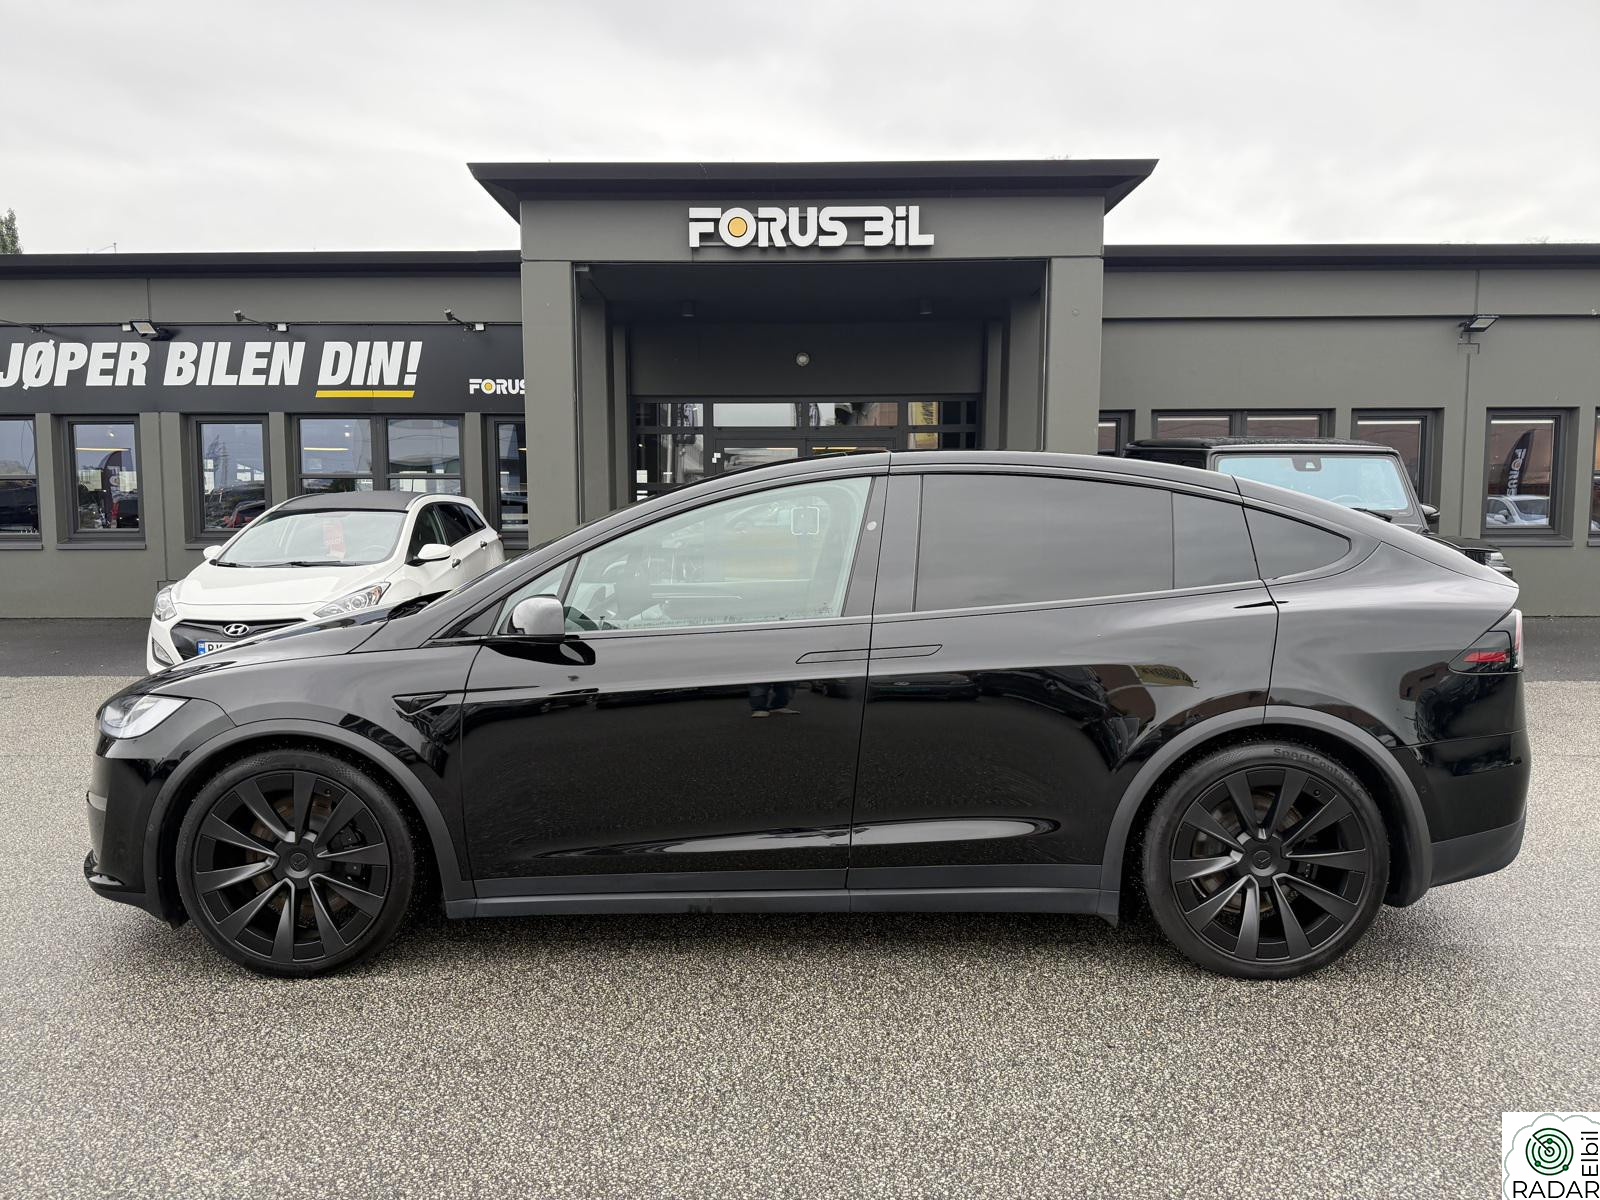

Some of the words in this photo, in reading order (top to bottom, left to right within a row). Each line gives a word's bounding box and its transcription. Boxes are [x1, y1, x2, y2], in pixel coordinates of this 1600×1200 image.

[688, 206, 848, 247] FORUS
[163, 341, 306, 386] BILEN
[317, 341, 423, 386] DIN!
